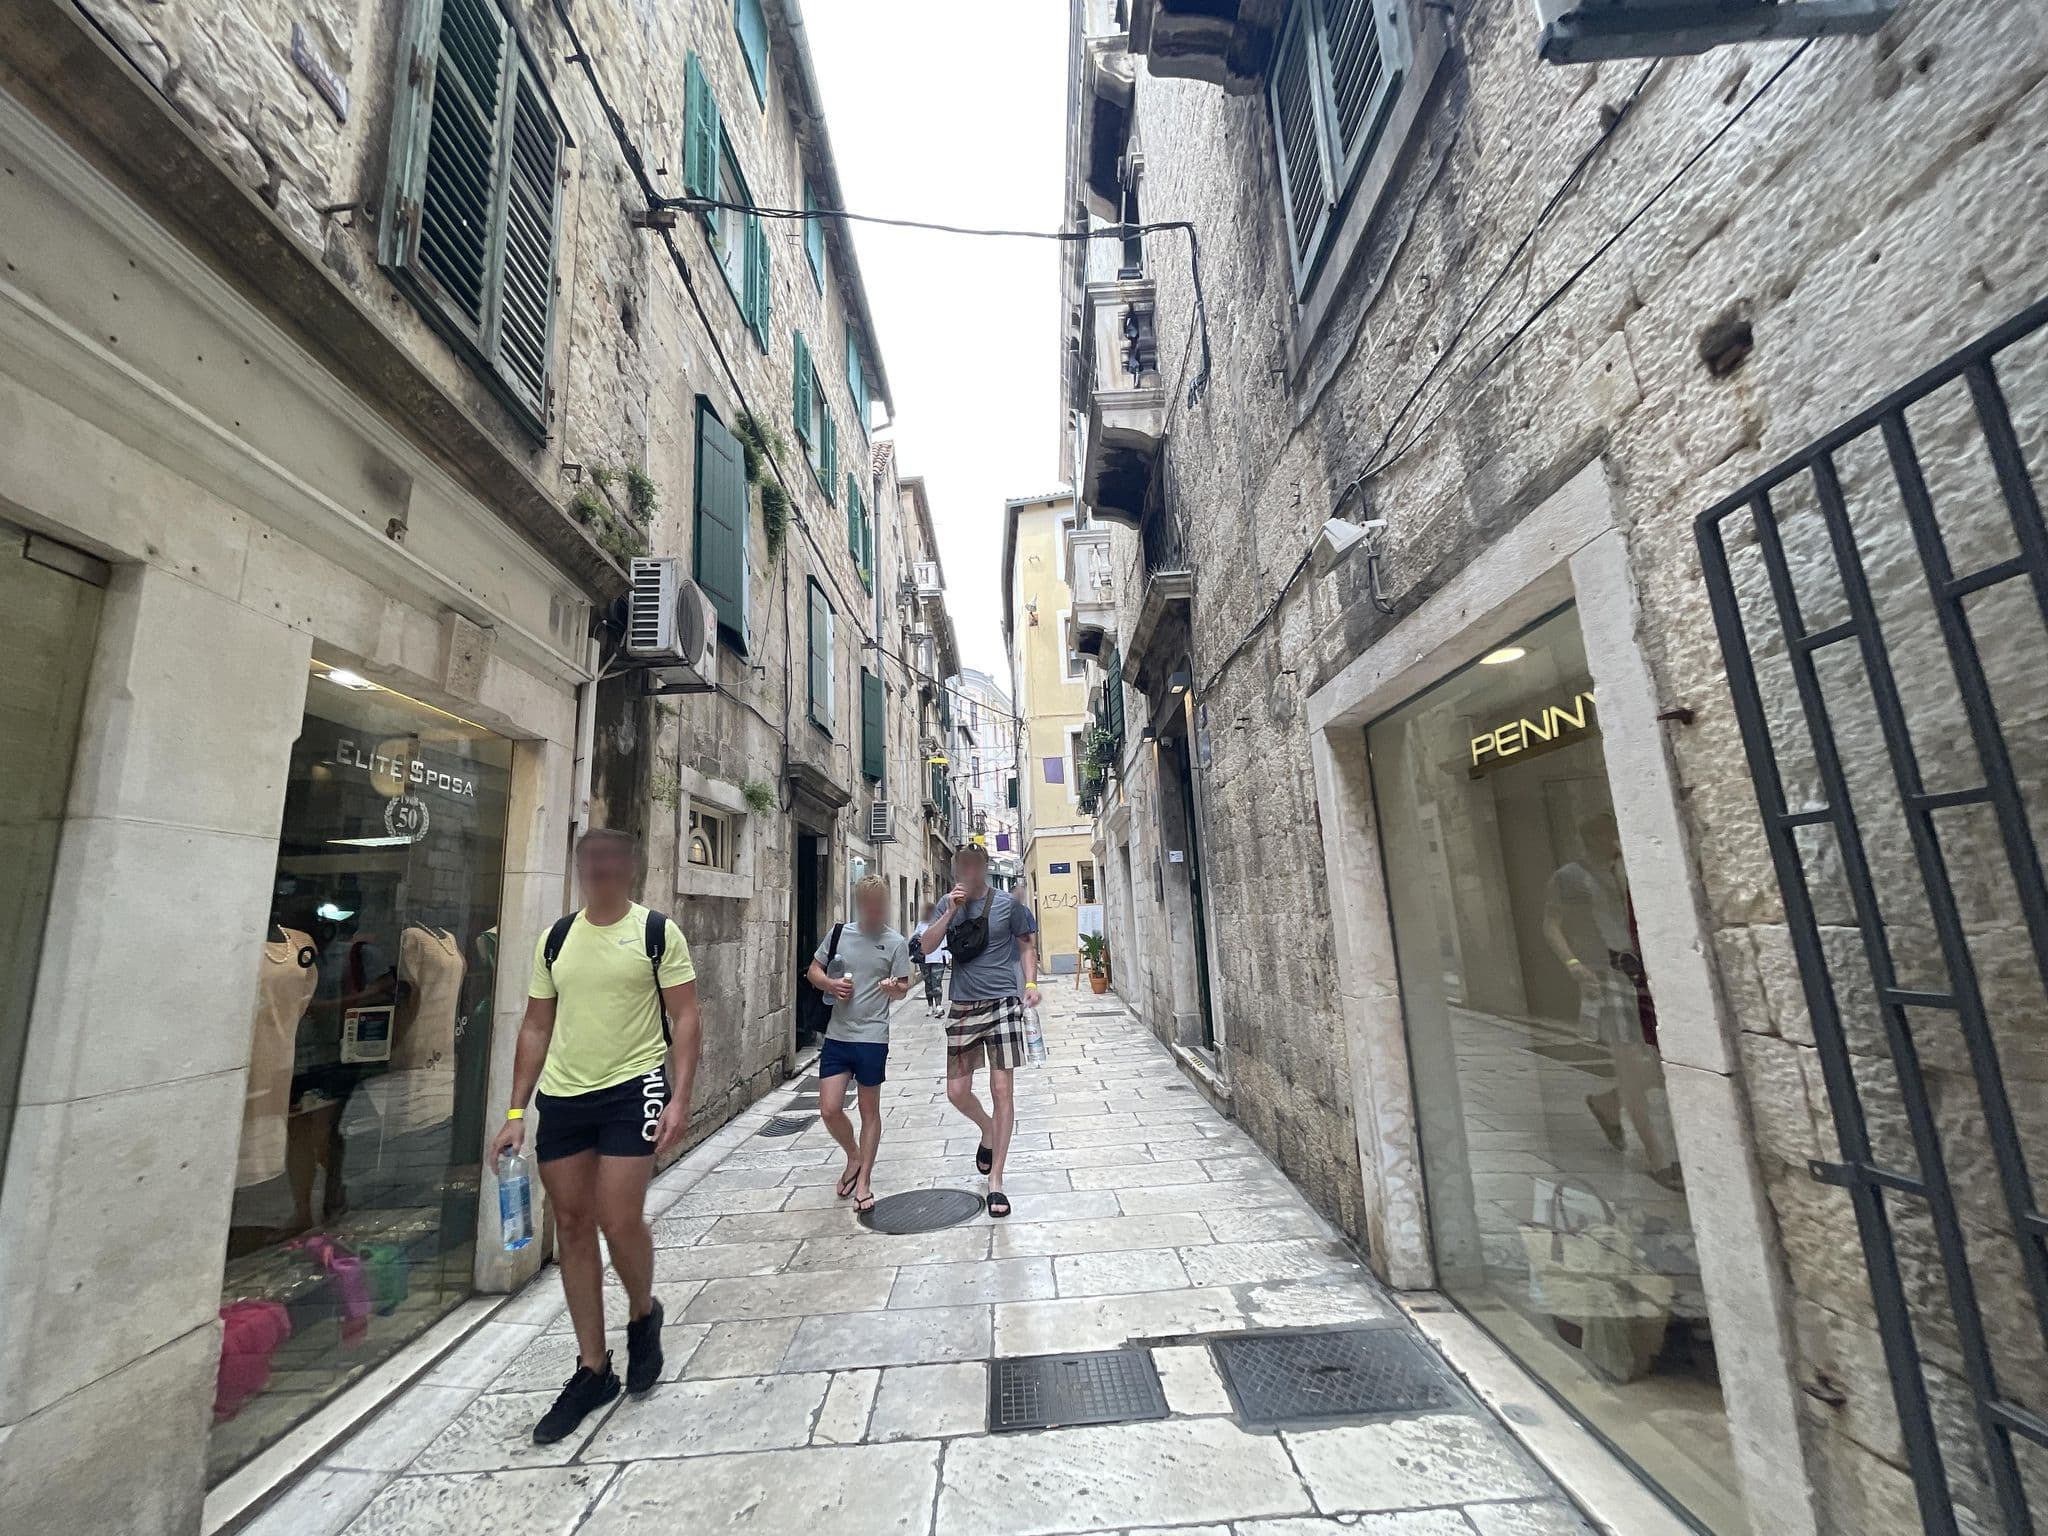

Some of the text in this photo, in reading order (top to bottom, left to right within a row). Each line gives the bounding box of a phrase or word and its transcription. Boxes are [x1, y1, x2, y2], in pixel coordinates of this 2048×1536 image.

[336, 738, 474, 797] ELITE SPOSA
[395, 807, 418, 829] 50
[1042, 893, 1078, 909] 1312
[641, 1068, 666, 1142] HUGO
